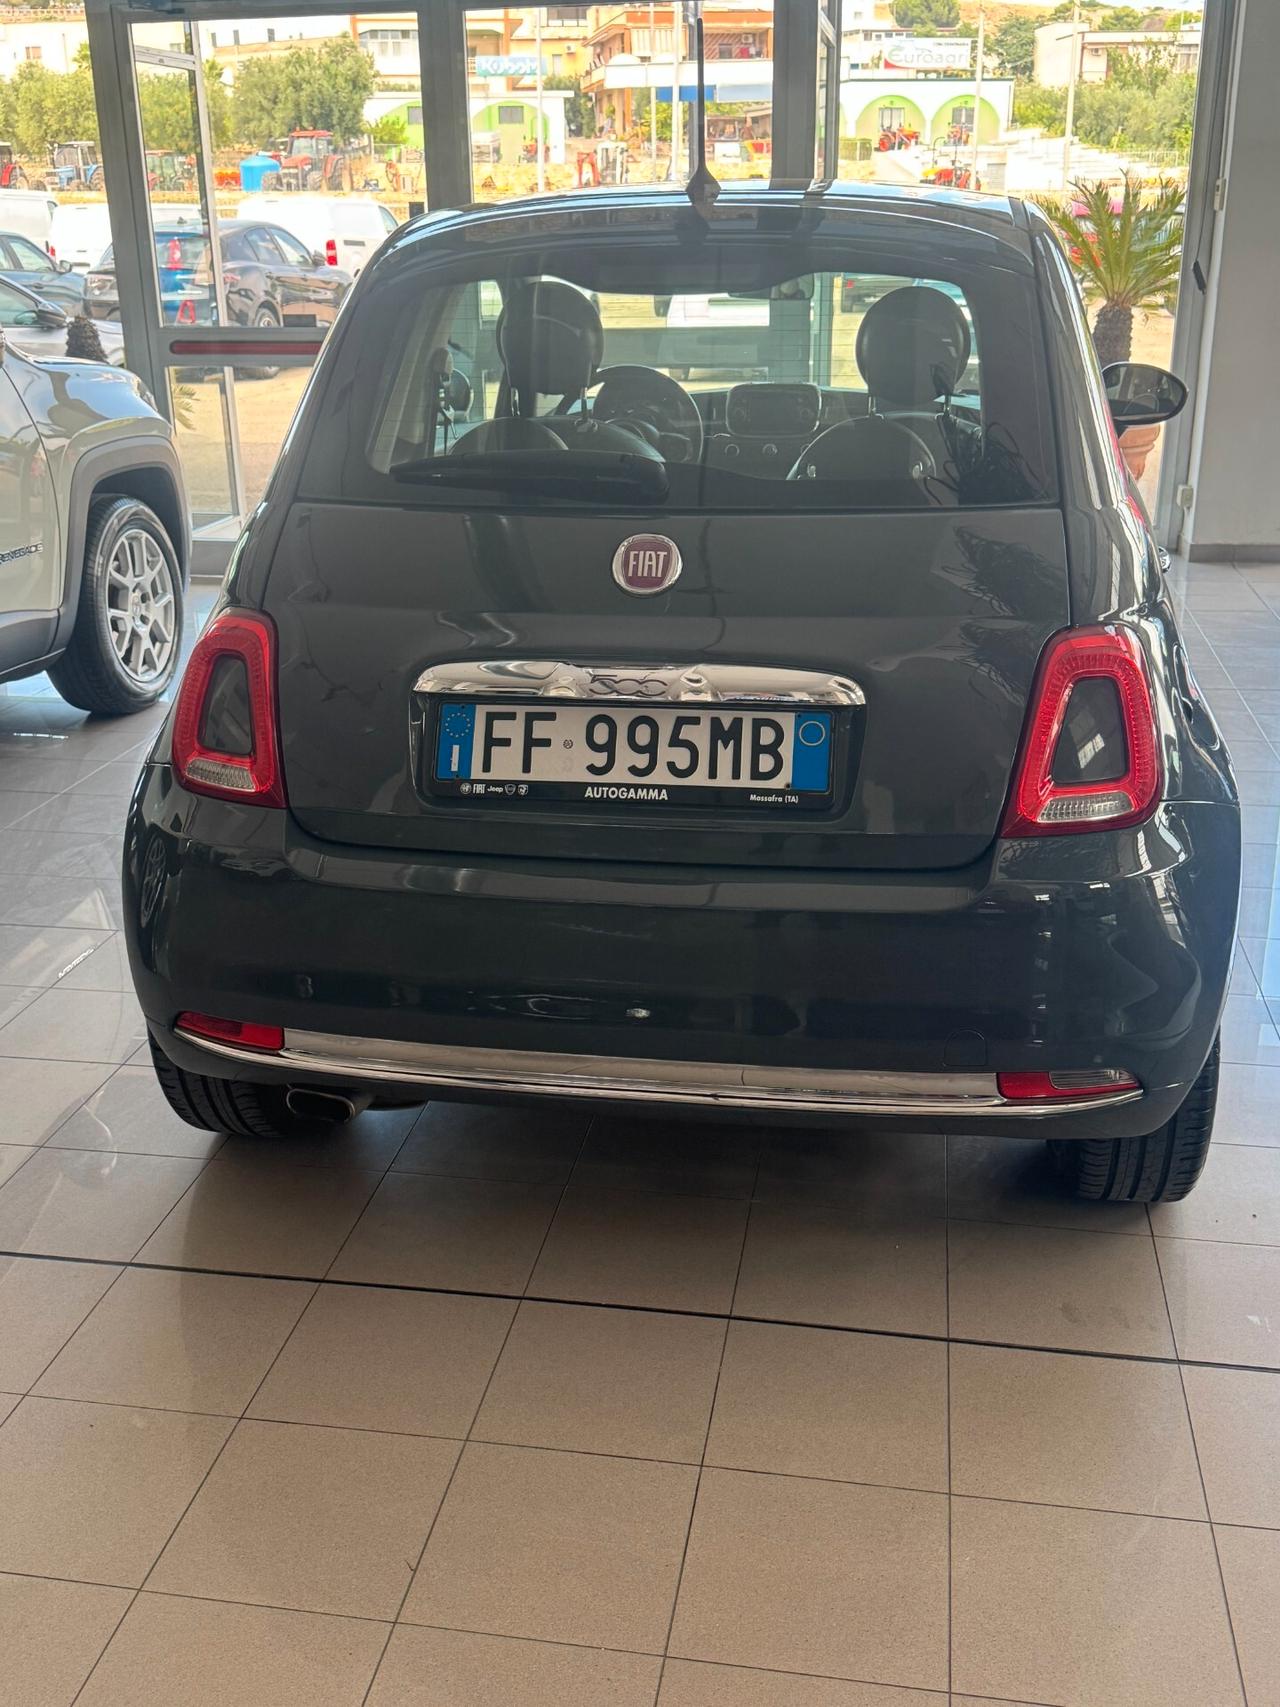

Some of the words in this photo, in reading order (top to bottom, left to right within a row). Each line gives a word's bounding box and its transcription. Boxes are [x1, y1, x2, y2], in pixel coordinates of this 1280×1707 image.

[628, 551, 667, 577] FIAT
[589, 675, 668, 696] 500
[482, 712, 557, 774] FF
[586, 714, 785, 780] 995MB
[487, 785, 503, 793] Jeep
[584, 786, 668, 800] AUTOGAMMA
[750, 794, 783, 802] Massafra
[784, 795, 799, 804] (TA)
